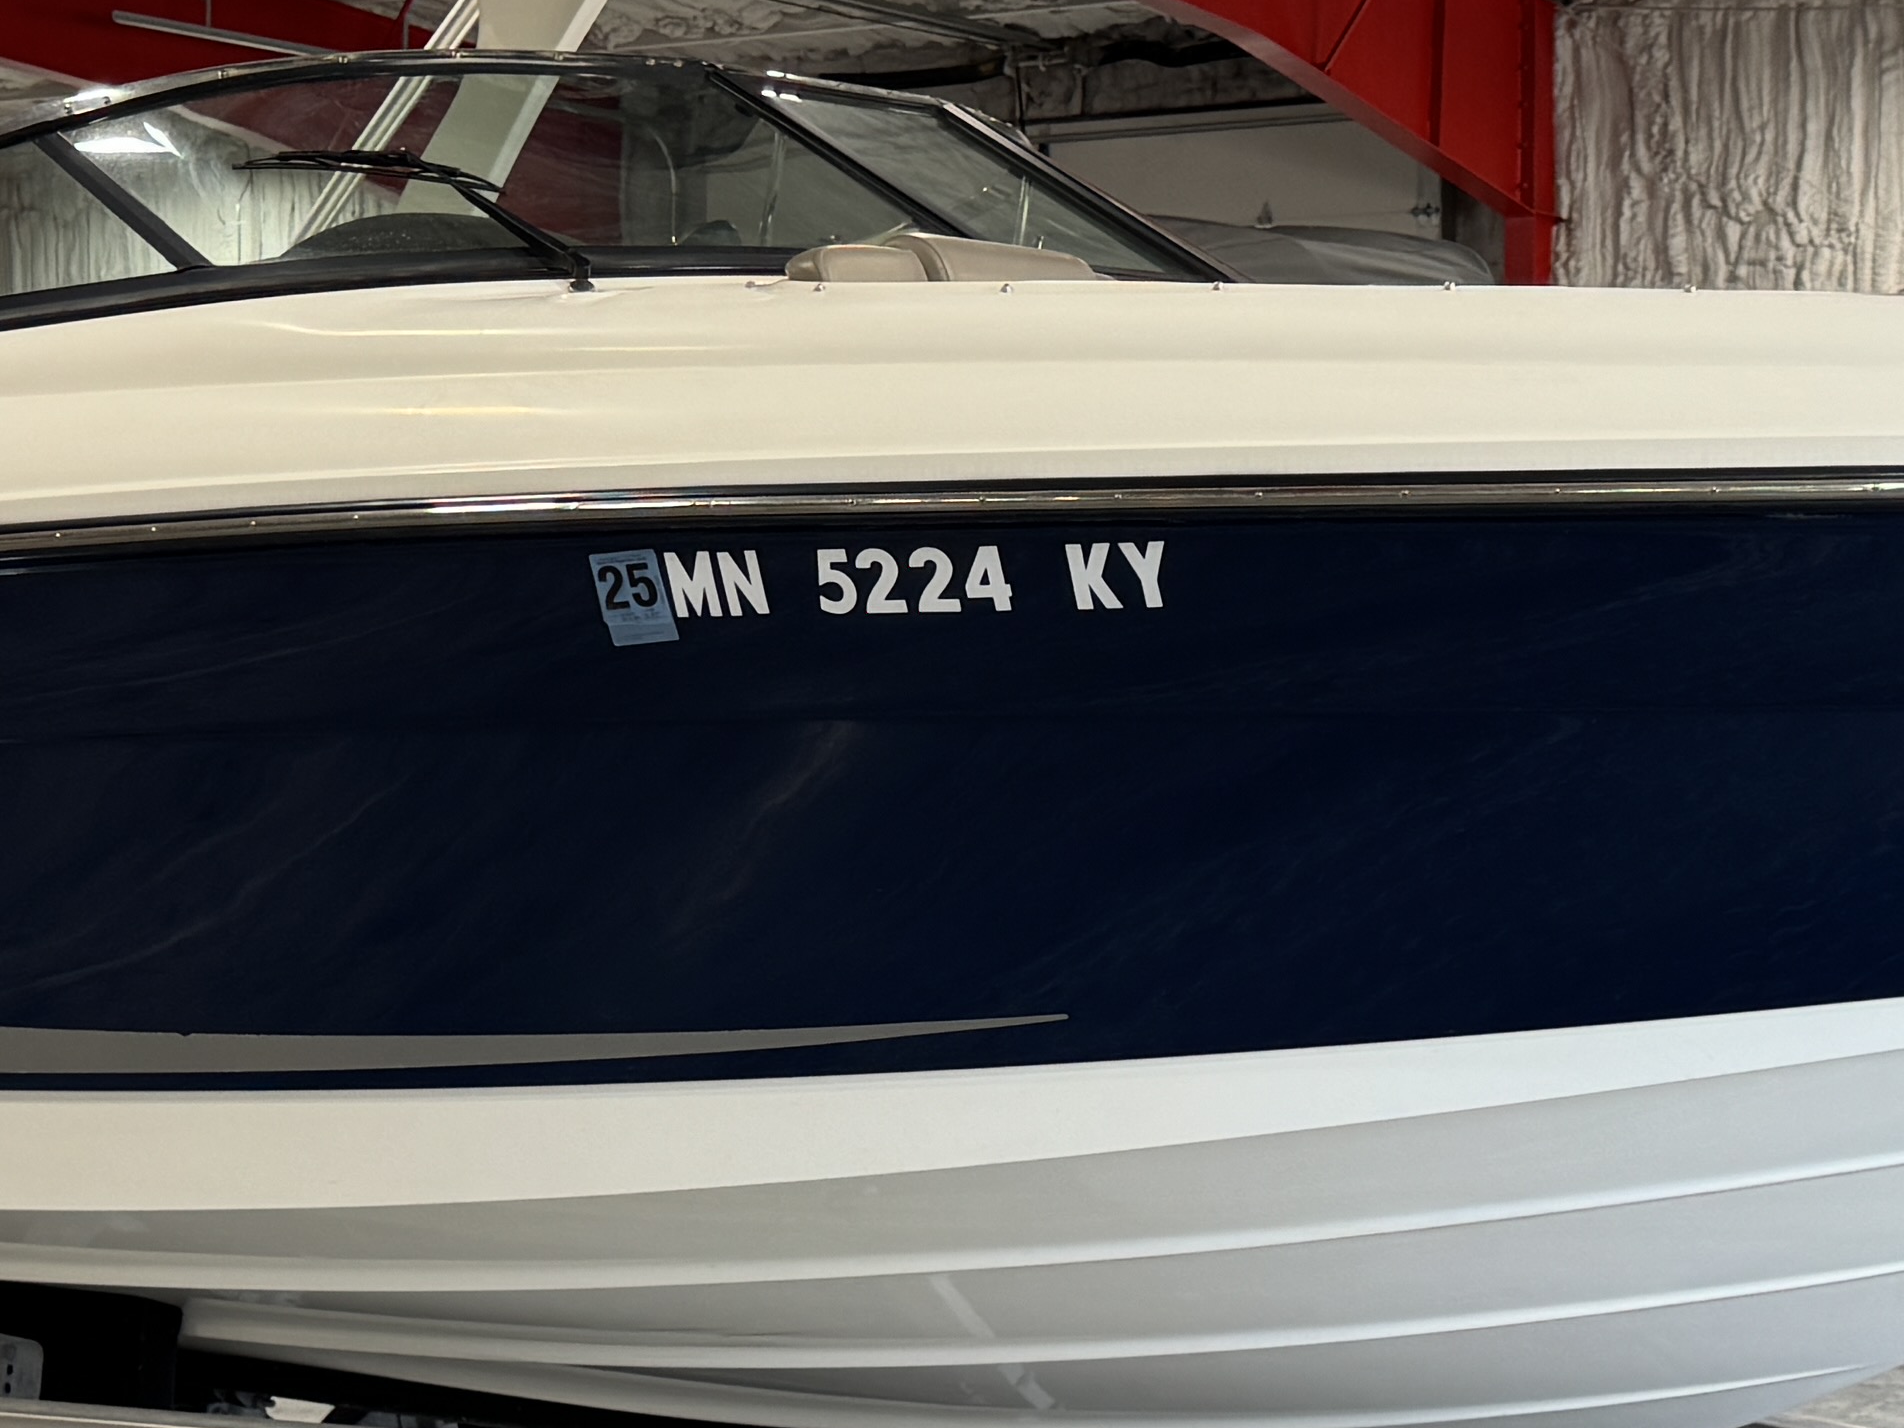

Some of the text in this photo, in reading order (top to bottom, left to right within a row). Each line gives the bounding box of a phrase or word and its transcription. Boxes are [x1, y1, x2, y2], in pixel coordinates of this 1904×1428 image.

[597, 562, 658, 611] 25
[663, 541, 1166, 618] MN 5224 KY
